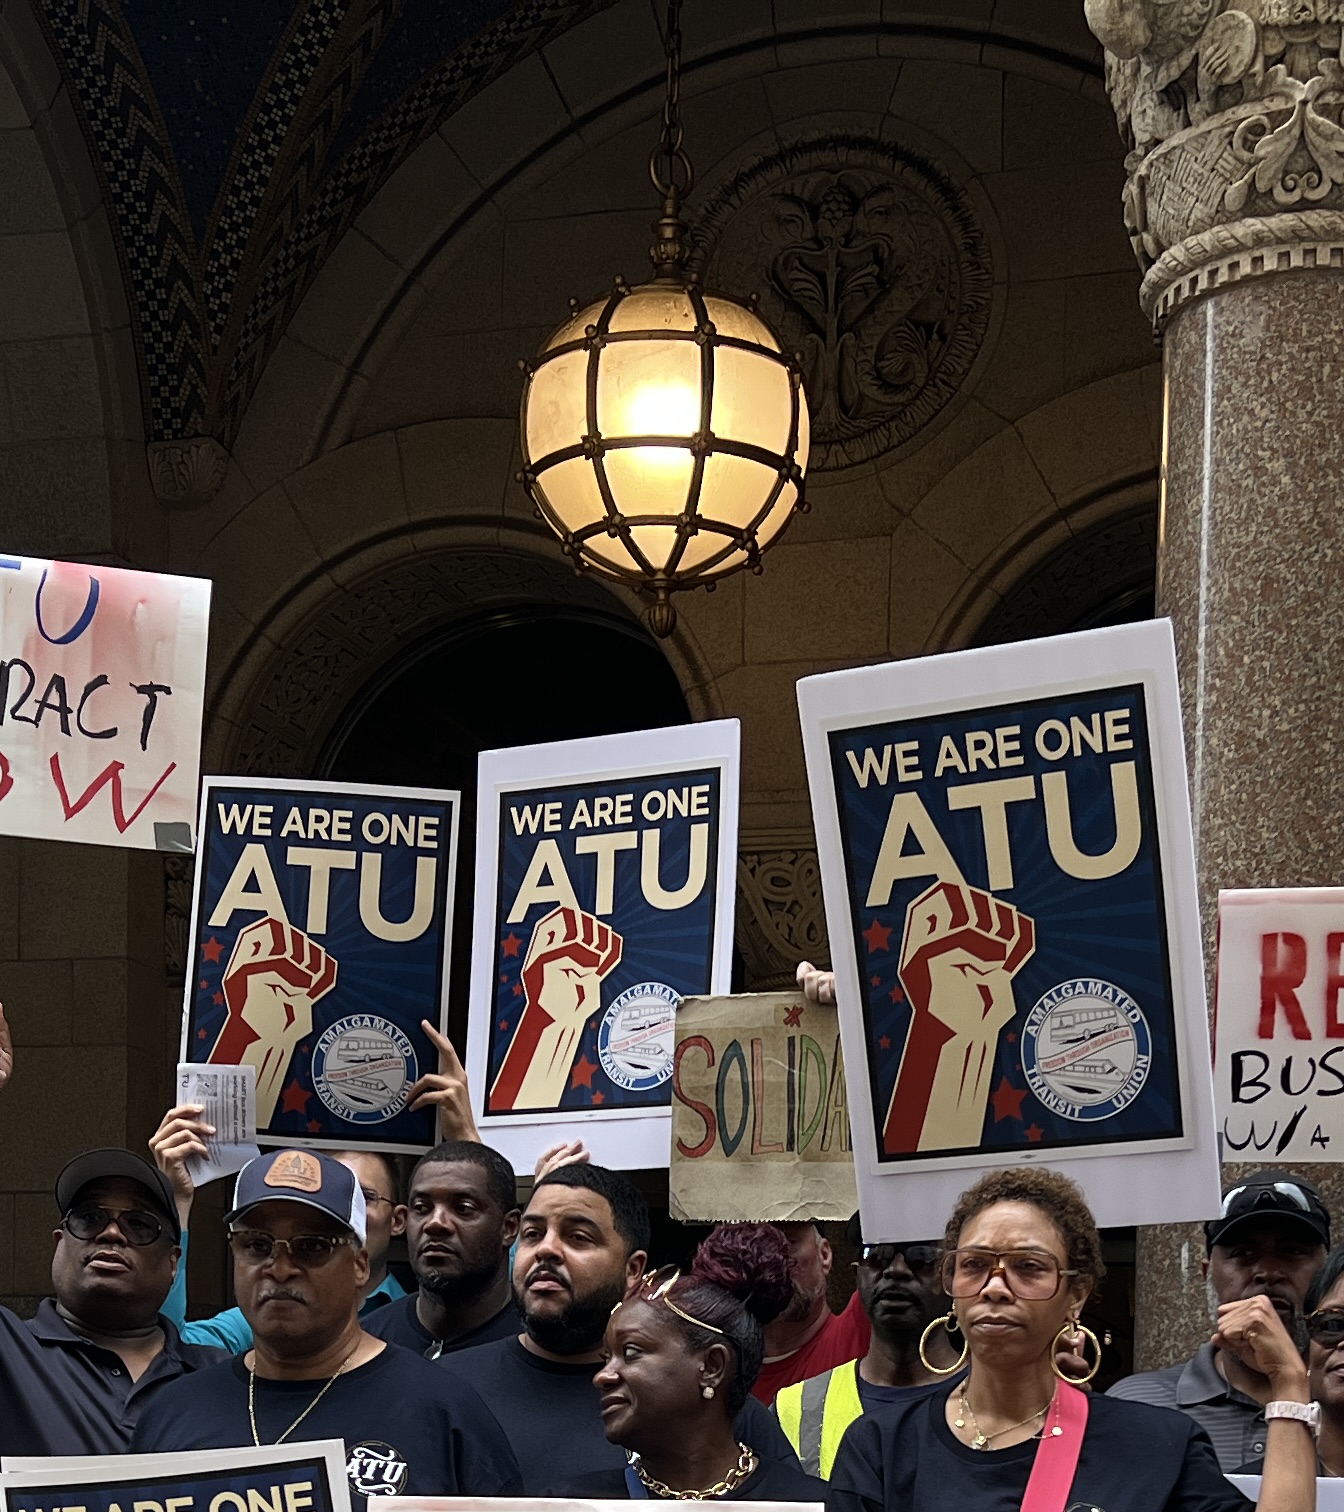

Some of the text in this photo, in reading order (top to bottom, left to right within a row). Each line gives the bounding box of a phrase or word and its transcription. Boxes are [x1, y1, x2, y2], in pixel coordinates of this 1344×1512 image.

[846, 708, 1134, 788] WE ARE ONE
[217, 803, 439, 849] WE ARE ONE
[510, 784, 710, 836] WE ARE ONE
[865, 760, 1142, 908] ATU
[208, 843, 437, 942] ATU
[507, 823, 708, 924] ATU
[319, 1016, 413, 1057] AMALGAMATED
[1026, 981, 1141, 1038] AMALGAMATED
[600, 1046, 636, 1088] TRANSIT
[1027, 1053, 1149, 1118] TRANSIT UNION
[314, 1074, 357, 1120] TRANSIT
[672, 1033, 853, 1159] SOLIDA
[346, 1457, 407, 1483] ATU
